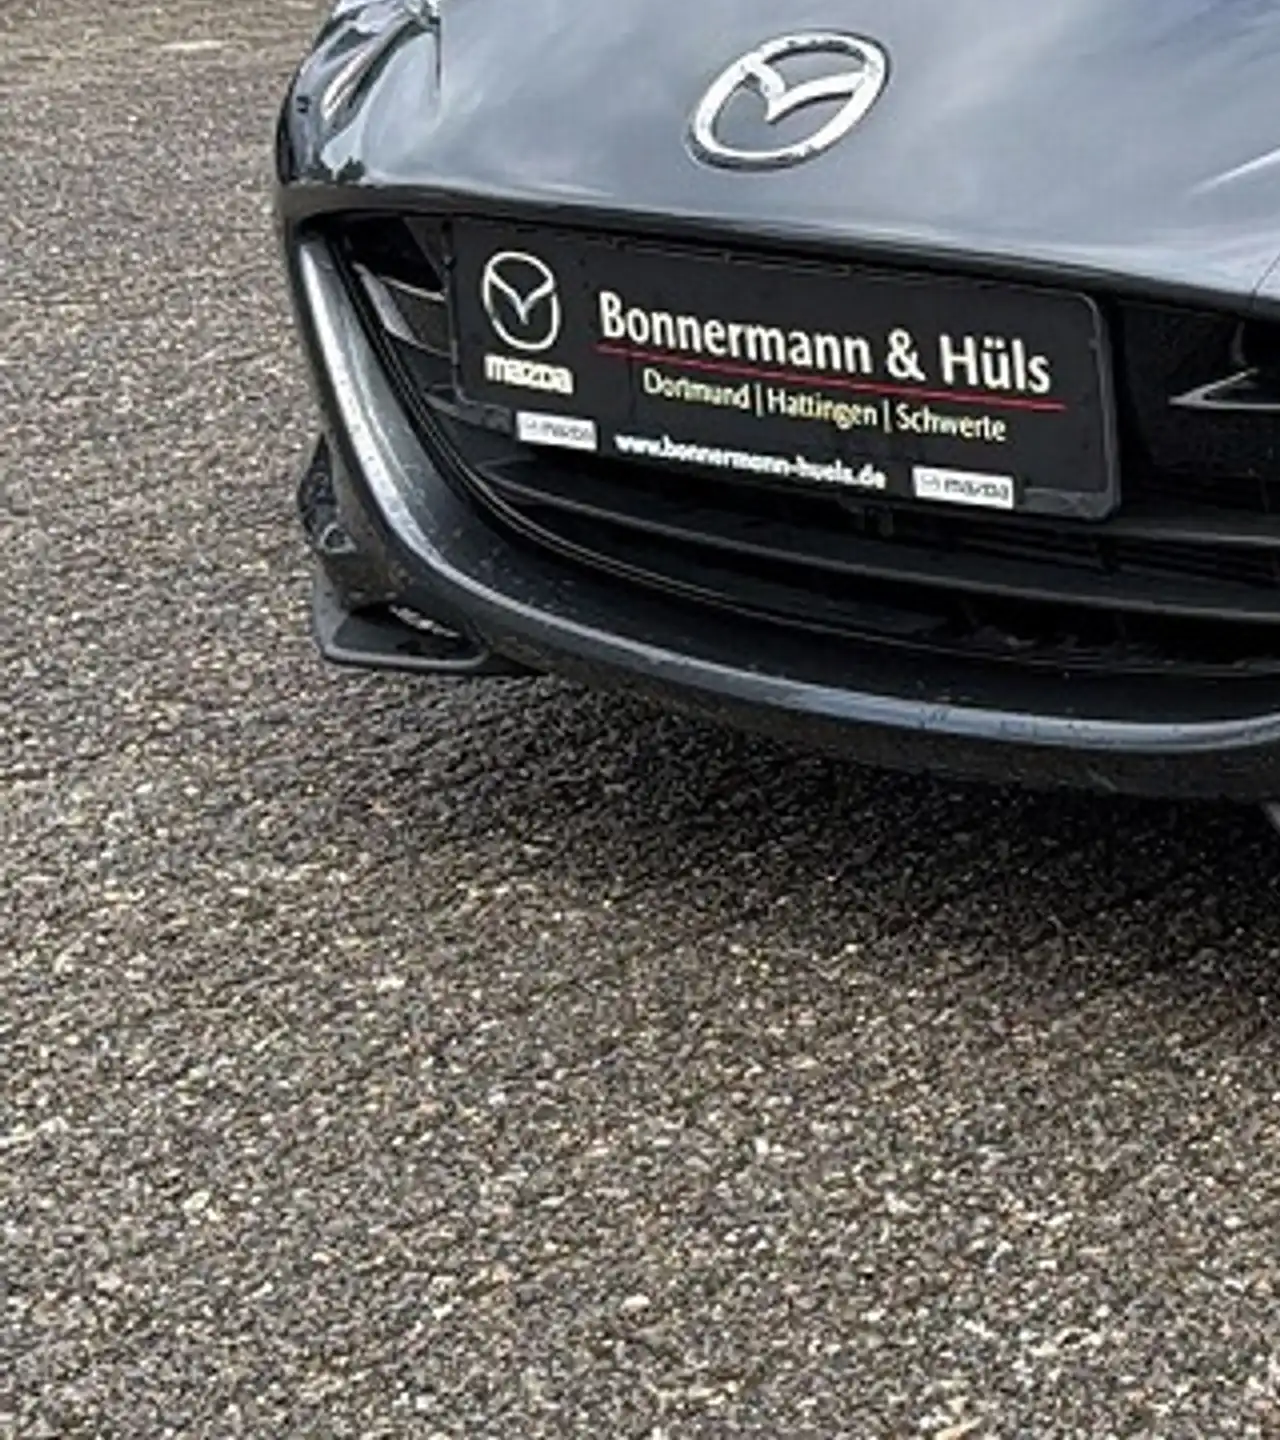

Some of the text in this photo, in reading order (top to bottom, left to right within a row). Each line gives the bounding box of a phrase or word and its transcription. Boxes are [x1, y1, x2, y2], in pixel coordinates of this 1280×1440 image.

[484, 353, 574, 395] mazda
[599, 290, 1051, 393] Bonnermann & Hüls
[643, 367, 751, 410] Dortmund
[766, 387, 878, 430] Hattingen
[895, 403, 1007, 442] Schwerte
[613, 434, 887, 490] www.bonnermann-huels.de
